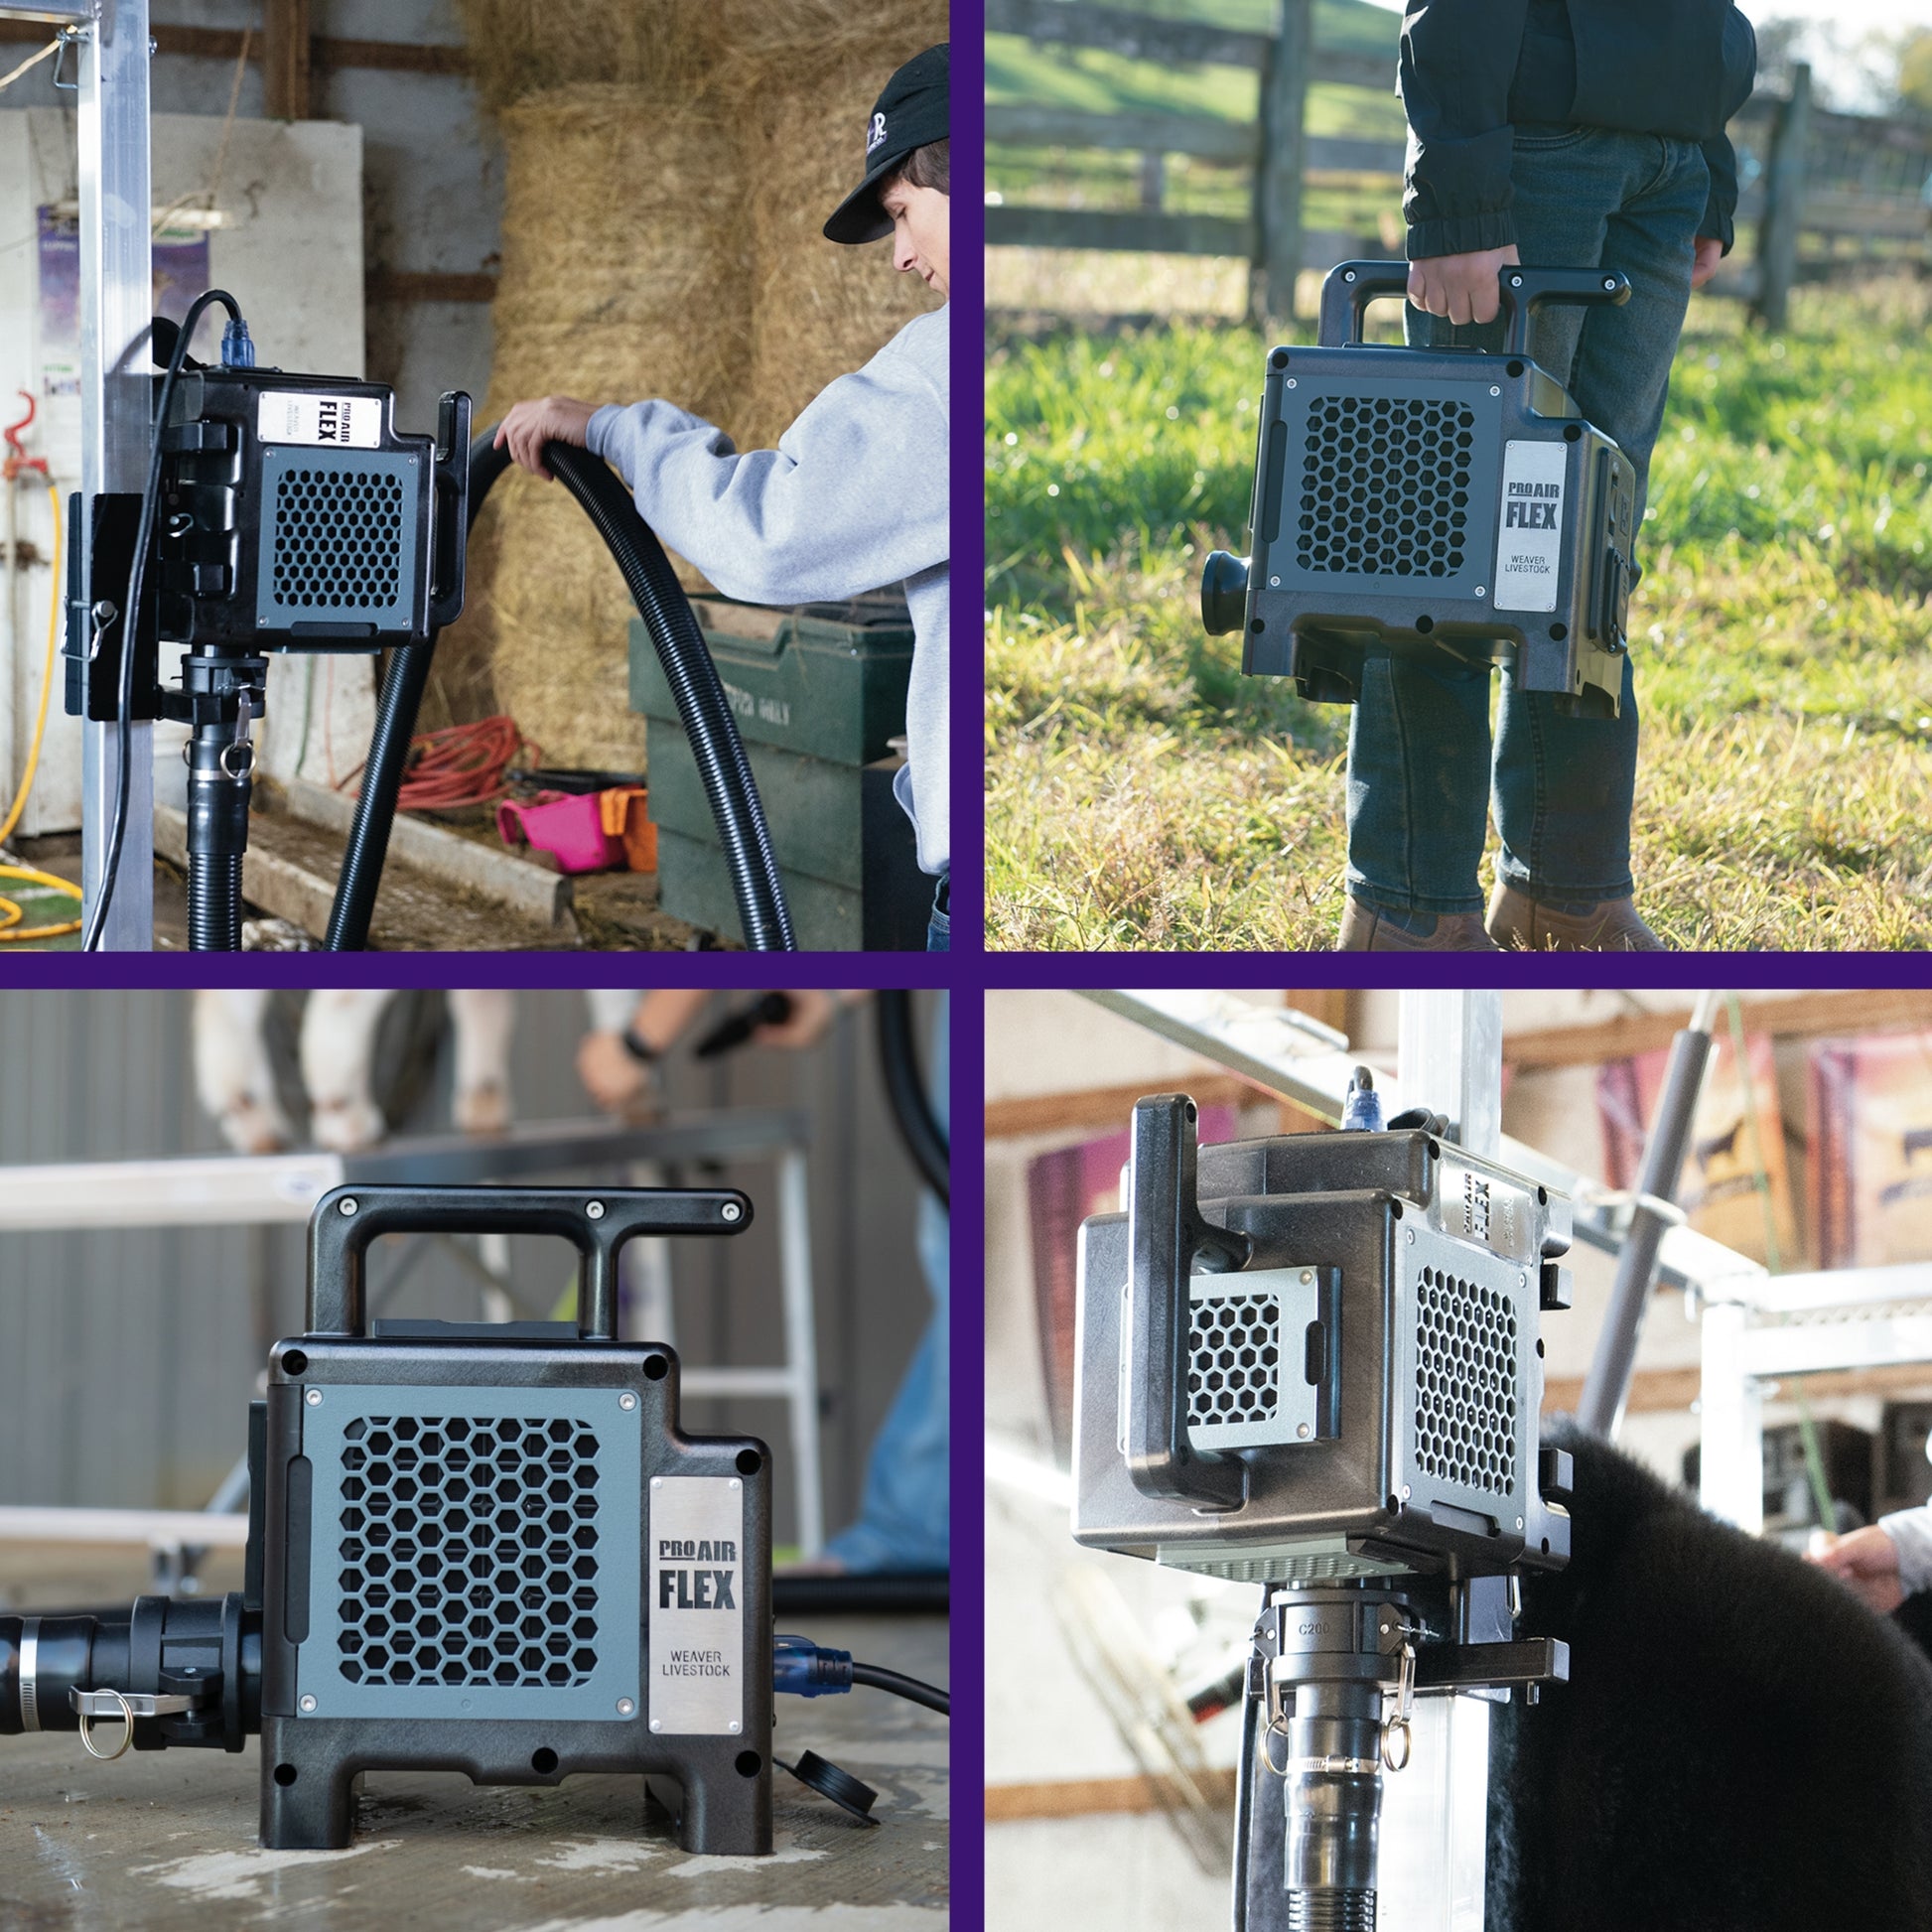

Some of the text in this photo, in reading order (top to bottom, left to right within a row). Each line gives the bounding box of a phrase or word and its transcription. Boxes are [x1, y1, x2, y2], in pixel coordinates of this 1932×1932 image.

[318, 401, 338, 441] FLEX
[1505, 501, 1557, 530] FLEX
[1511, 555, 1545, 565] WEAVER
[1505, 564, 1550, 574] LIVESTOCK
[1473, 1179, 1490, 1241] FLEX
[659, 1570, 736, 1609] FLEX
[1299, 1622, 1330, 1636] C200
[670, 1650, 722, 1663] WEAVER
[662, 1664, 730, 1677] LIVESTOCK
